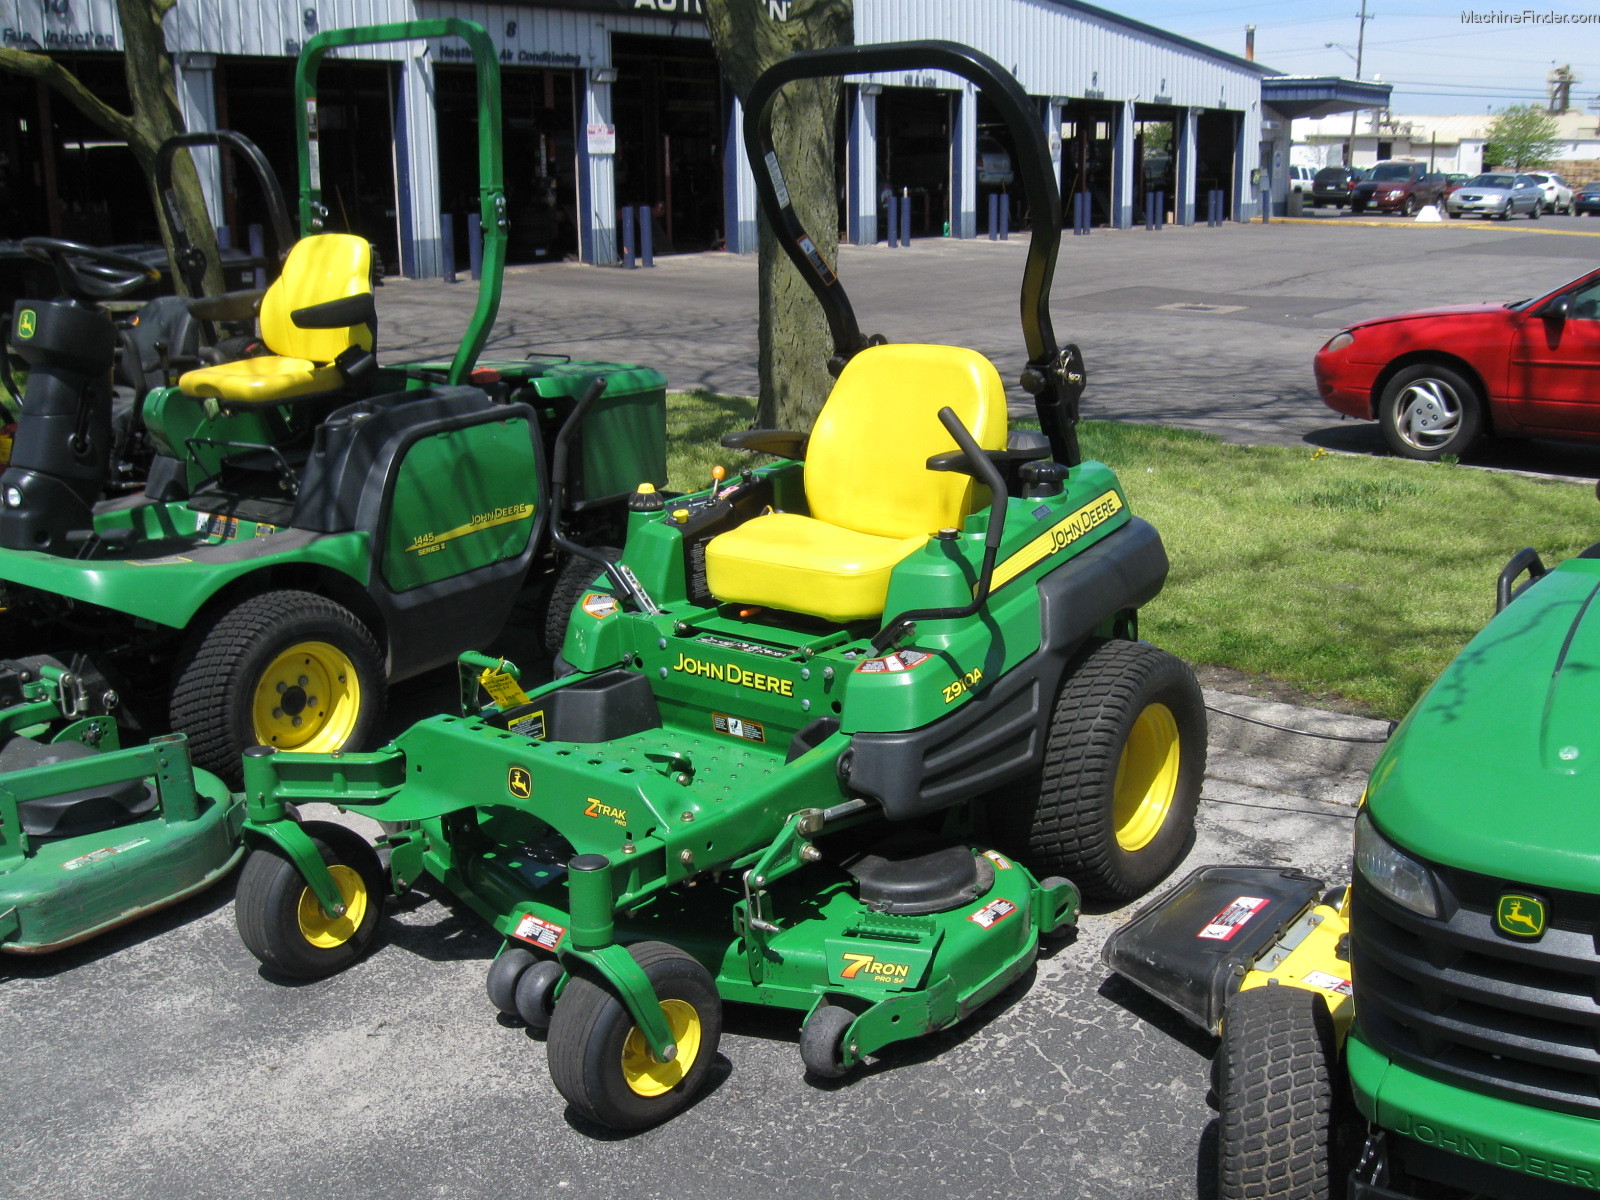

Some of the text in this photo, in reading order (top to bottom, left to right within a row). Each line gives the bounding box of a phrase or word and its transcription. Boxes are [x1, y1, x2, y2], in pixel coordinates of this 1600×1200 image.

[304, 8, 316, 25] 9
[506, 21, 516, 38] 8
[518, 51, 581, 65] Conditioning
[469, 503, 527, 526] JOHN DEERE
[1051, 520, 1082, 552] JOHN
[1080, 498, 1116, 530] DEERE
[413, 532, 436, 546] 1445
[418, 545, 440, 556] SERIES
[673, 652, 795, 698] JOHN DEERE
[942, 667, 984, 705] Z910A
[614, 818, 628, 828] PRO
[874, 975, 892, 984] PRO
[1395, 1114, 1600, 1191] JOHN DEER
